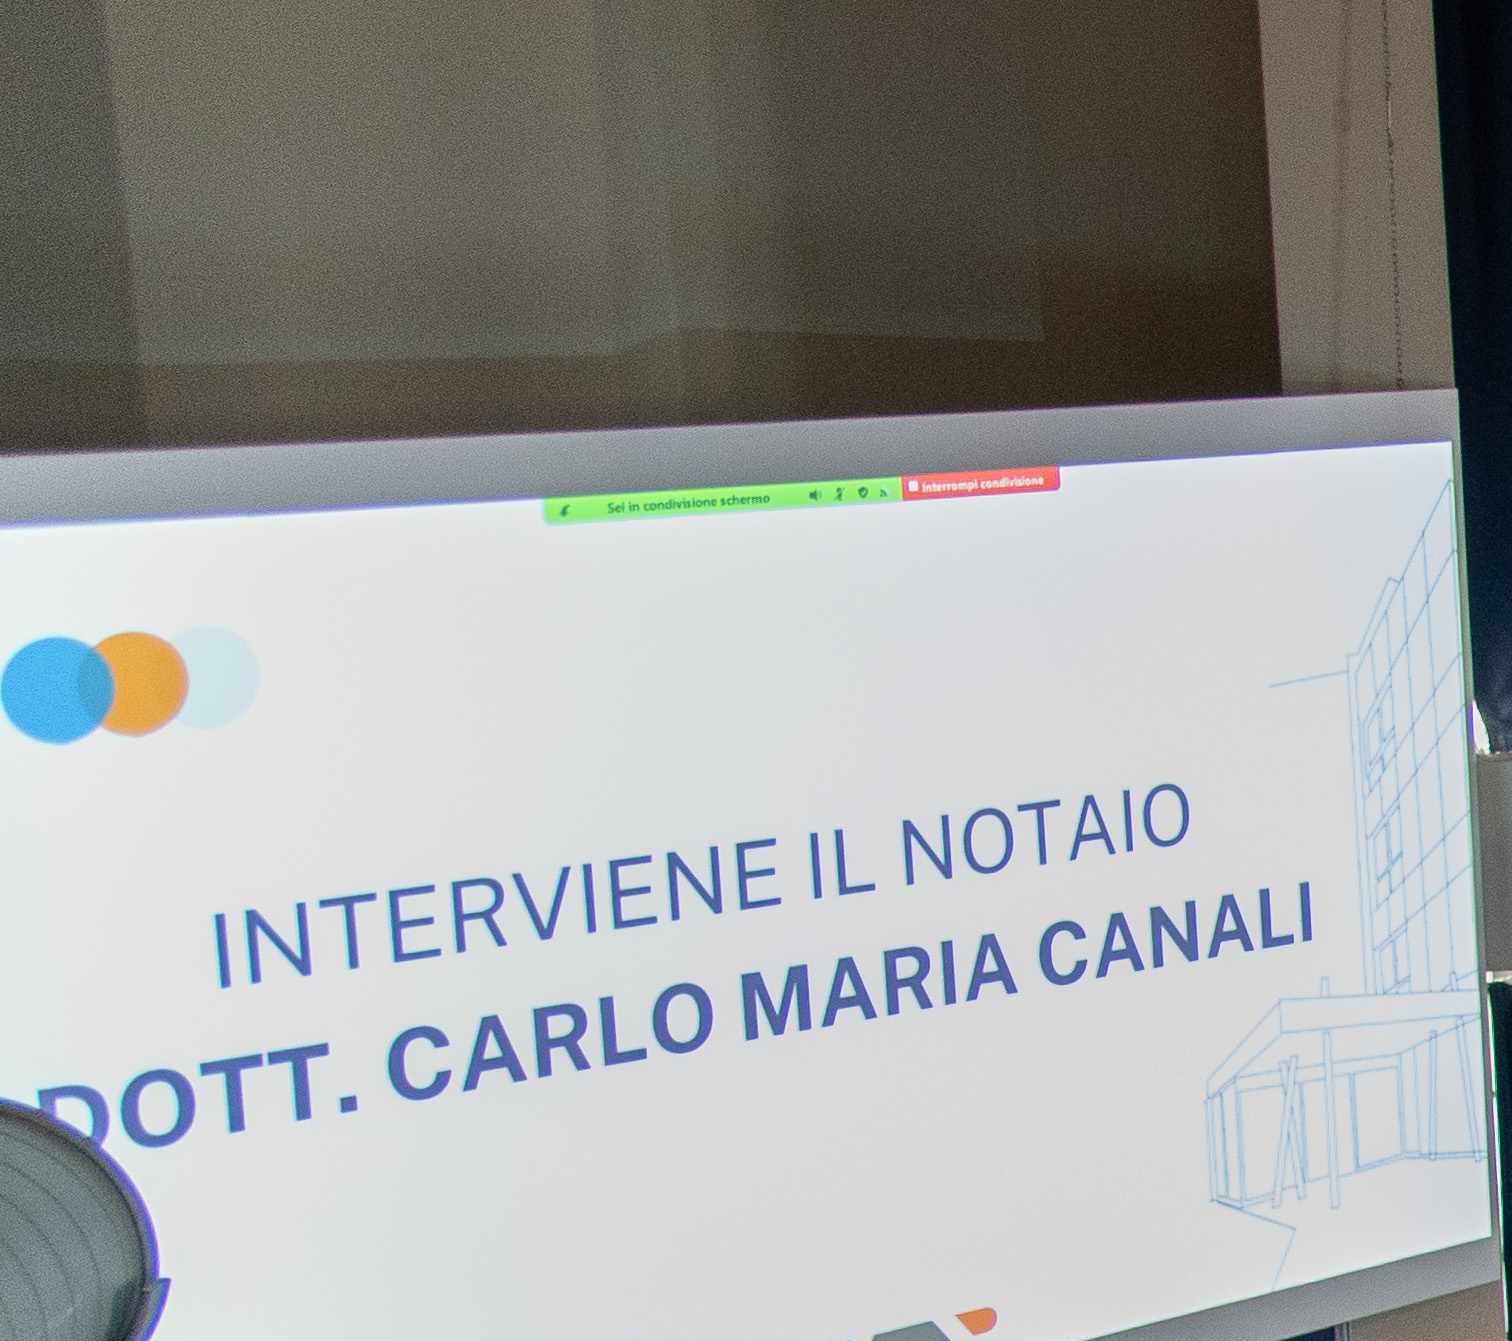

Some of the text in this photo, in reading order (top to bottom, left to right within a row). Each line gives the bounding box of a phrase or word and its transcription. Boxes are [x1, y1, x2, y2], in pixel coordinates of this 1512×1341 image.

[607, 492, 771, 515] Sei in condivisione schermo
[921, 473, 1045, 495] Interrompi condivisione
[212, 781, 1193, 988] INTERVIENE IL NOTAIO
[36, 880, 1316, 1150] DOTT. CARLO MARIA CANALI
